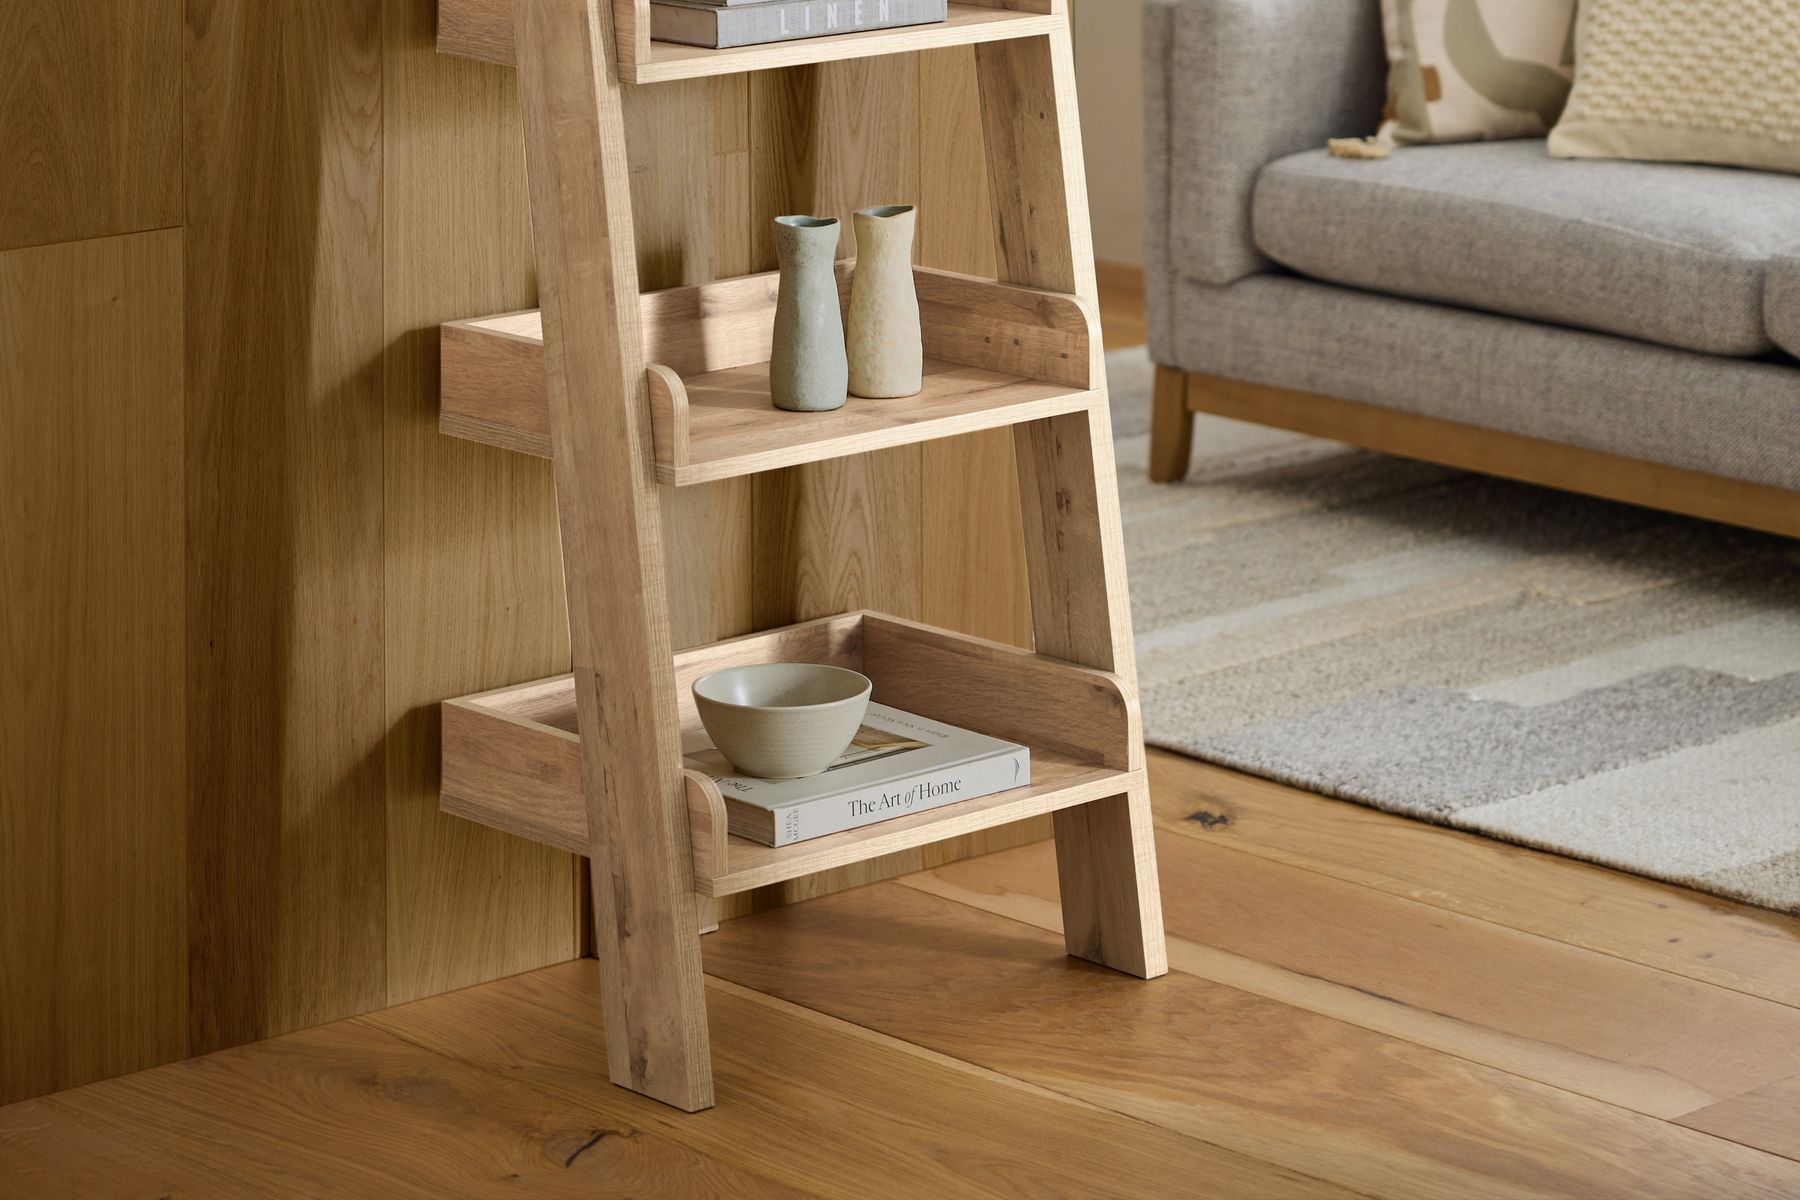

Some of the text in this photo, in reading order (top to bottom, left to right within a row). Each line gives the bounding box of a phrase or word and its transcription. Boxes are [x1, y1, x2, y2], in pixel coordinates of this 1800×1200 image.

[848, 779, 961, 817] The Art of Home
